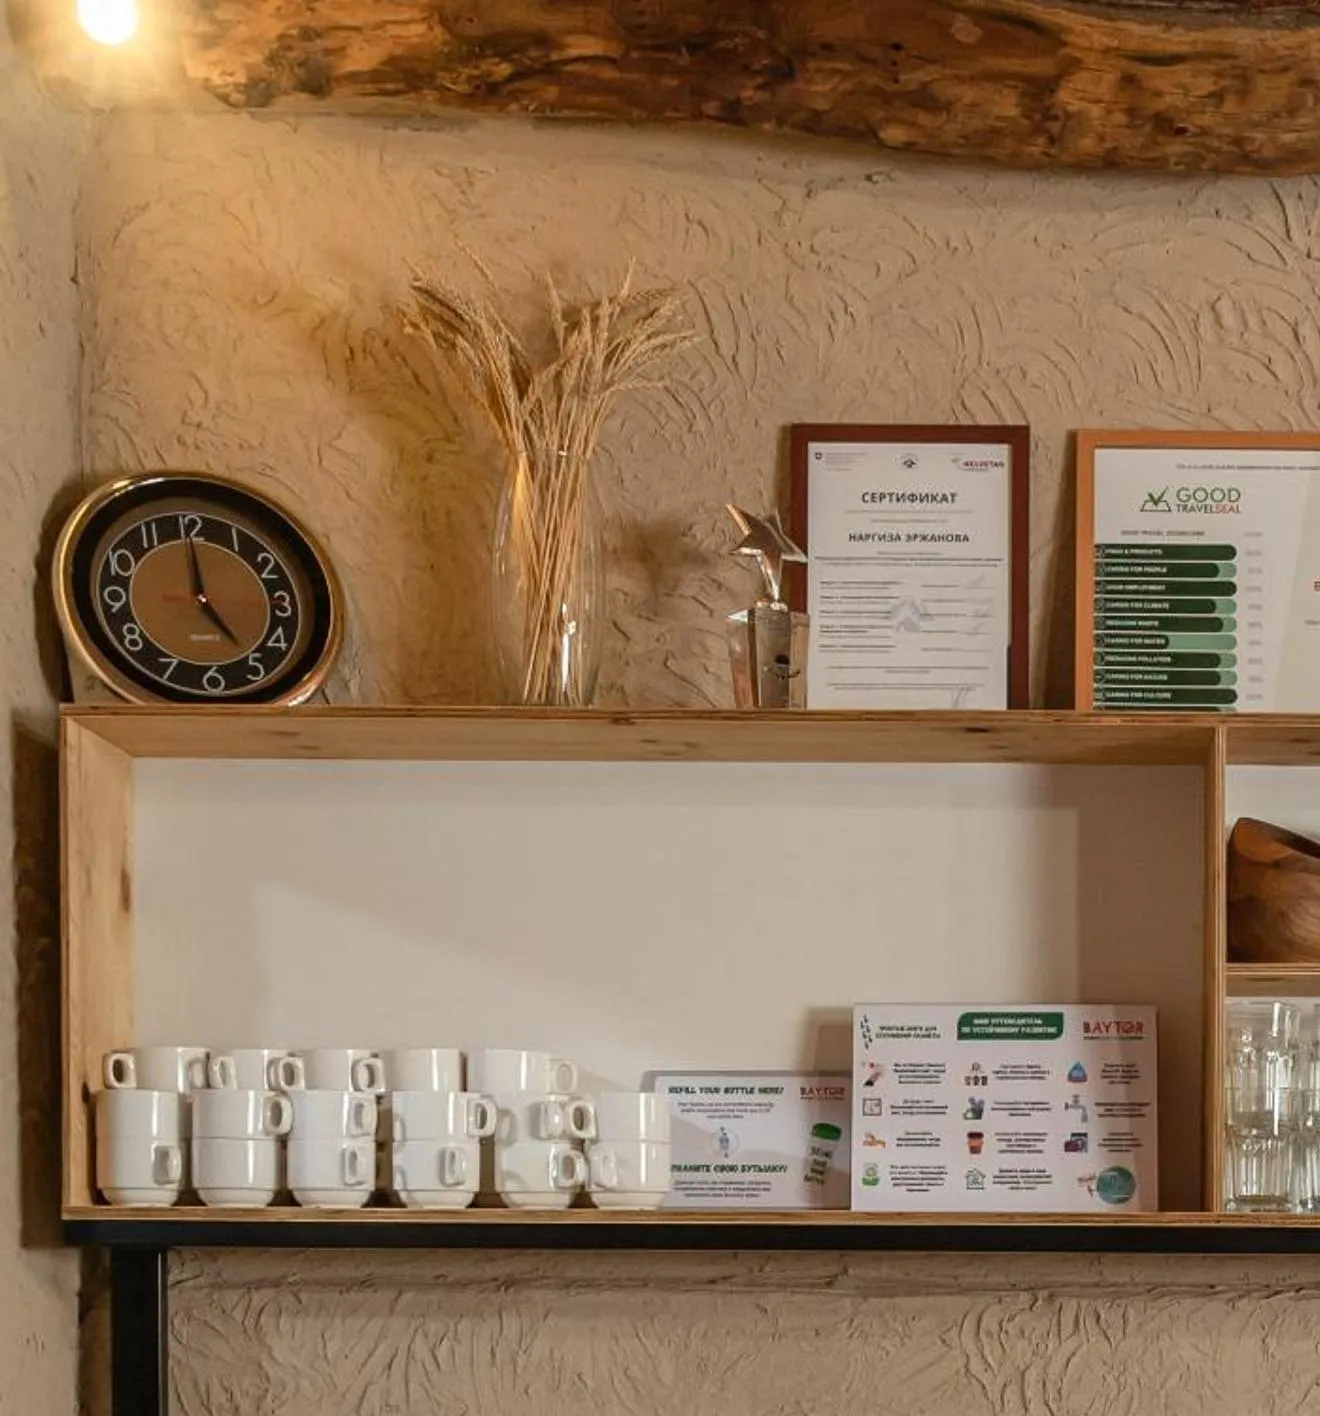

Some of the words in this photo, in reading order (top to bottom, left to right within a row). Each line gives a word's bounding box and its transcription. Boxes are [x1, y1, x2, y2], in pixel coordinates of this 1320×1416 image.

[861, 491, 957, 504] СЕРТИФИКАТ
[1176, 487, 1241, 503] GOOD
[1176, 503, 1242, 514] TRAVELSEAL
[140, 521, 158, 549] 11
[178, 514, 206, 541] 12
[231, 527, 240, 552] 1
[848, 533, 901, 543] НАРГИЗА
[905, 533, 969, 543] ЭРЖАНОВА
[108, 549, 136, 577] 10
[256, 552, 279, 579] 2
[103, 586, 127, 614] 9
[273, 591, 292, 617] 3
[122, 622, 144, 652] 8
[266, 626, 289, 651] 4
[158, 658, 181, 681] 7
[202, 665, 226, 693] 6
[247, 653, 266, 681] 5
[1083, 1020, 1144, 1034] BAYTOR
[668, 1086, 696, 1094] REFILL
[699, 1086, 721, 1094] YOUR
[723, 1086, 755, 1095] BOTTLE
[800, 1087, 845, 1095] BAYTOR
